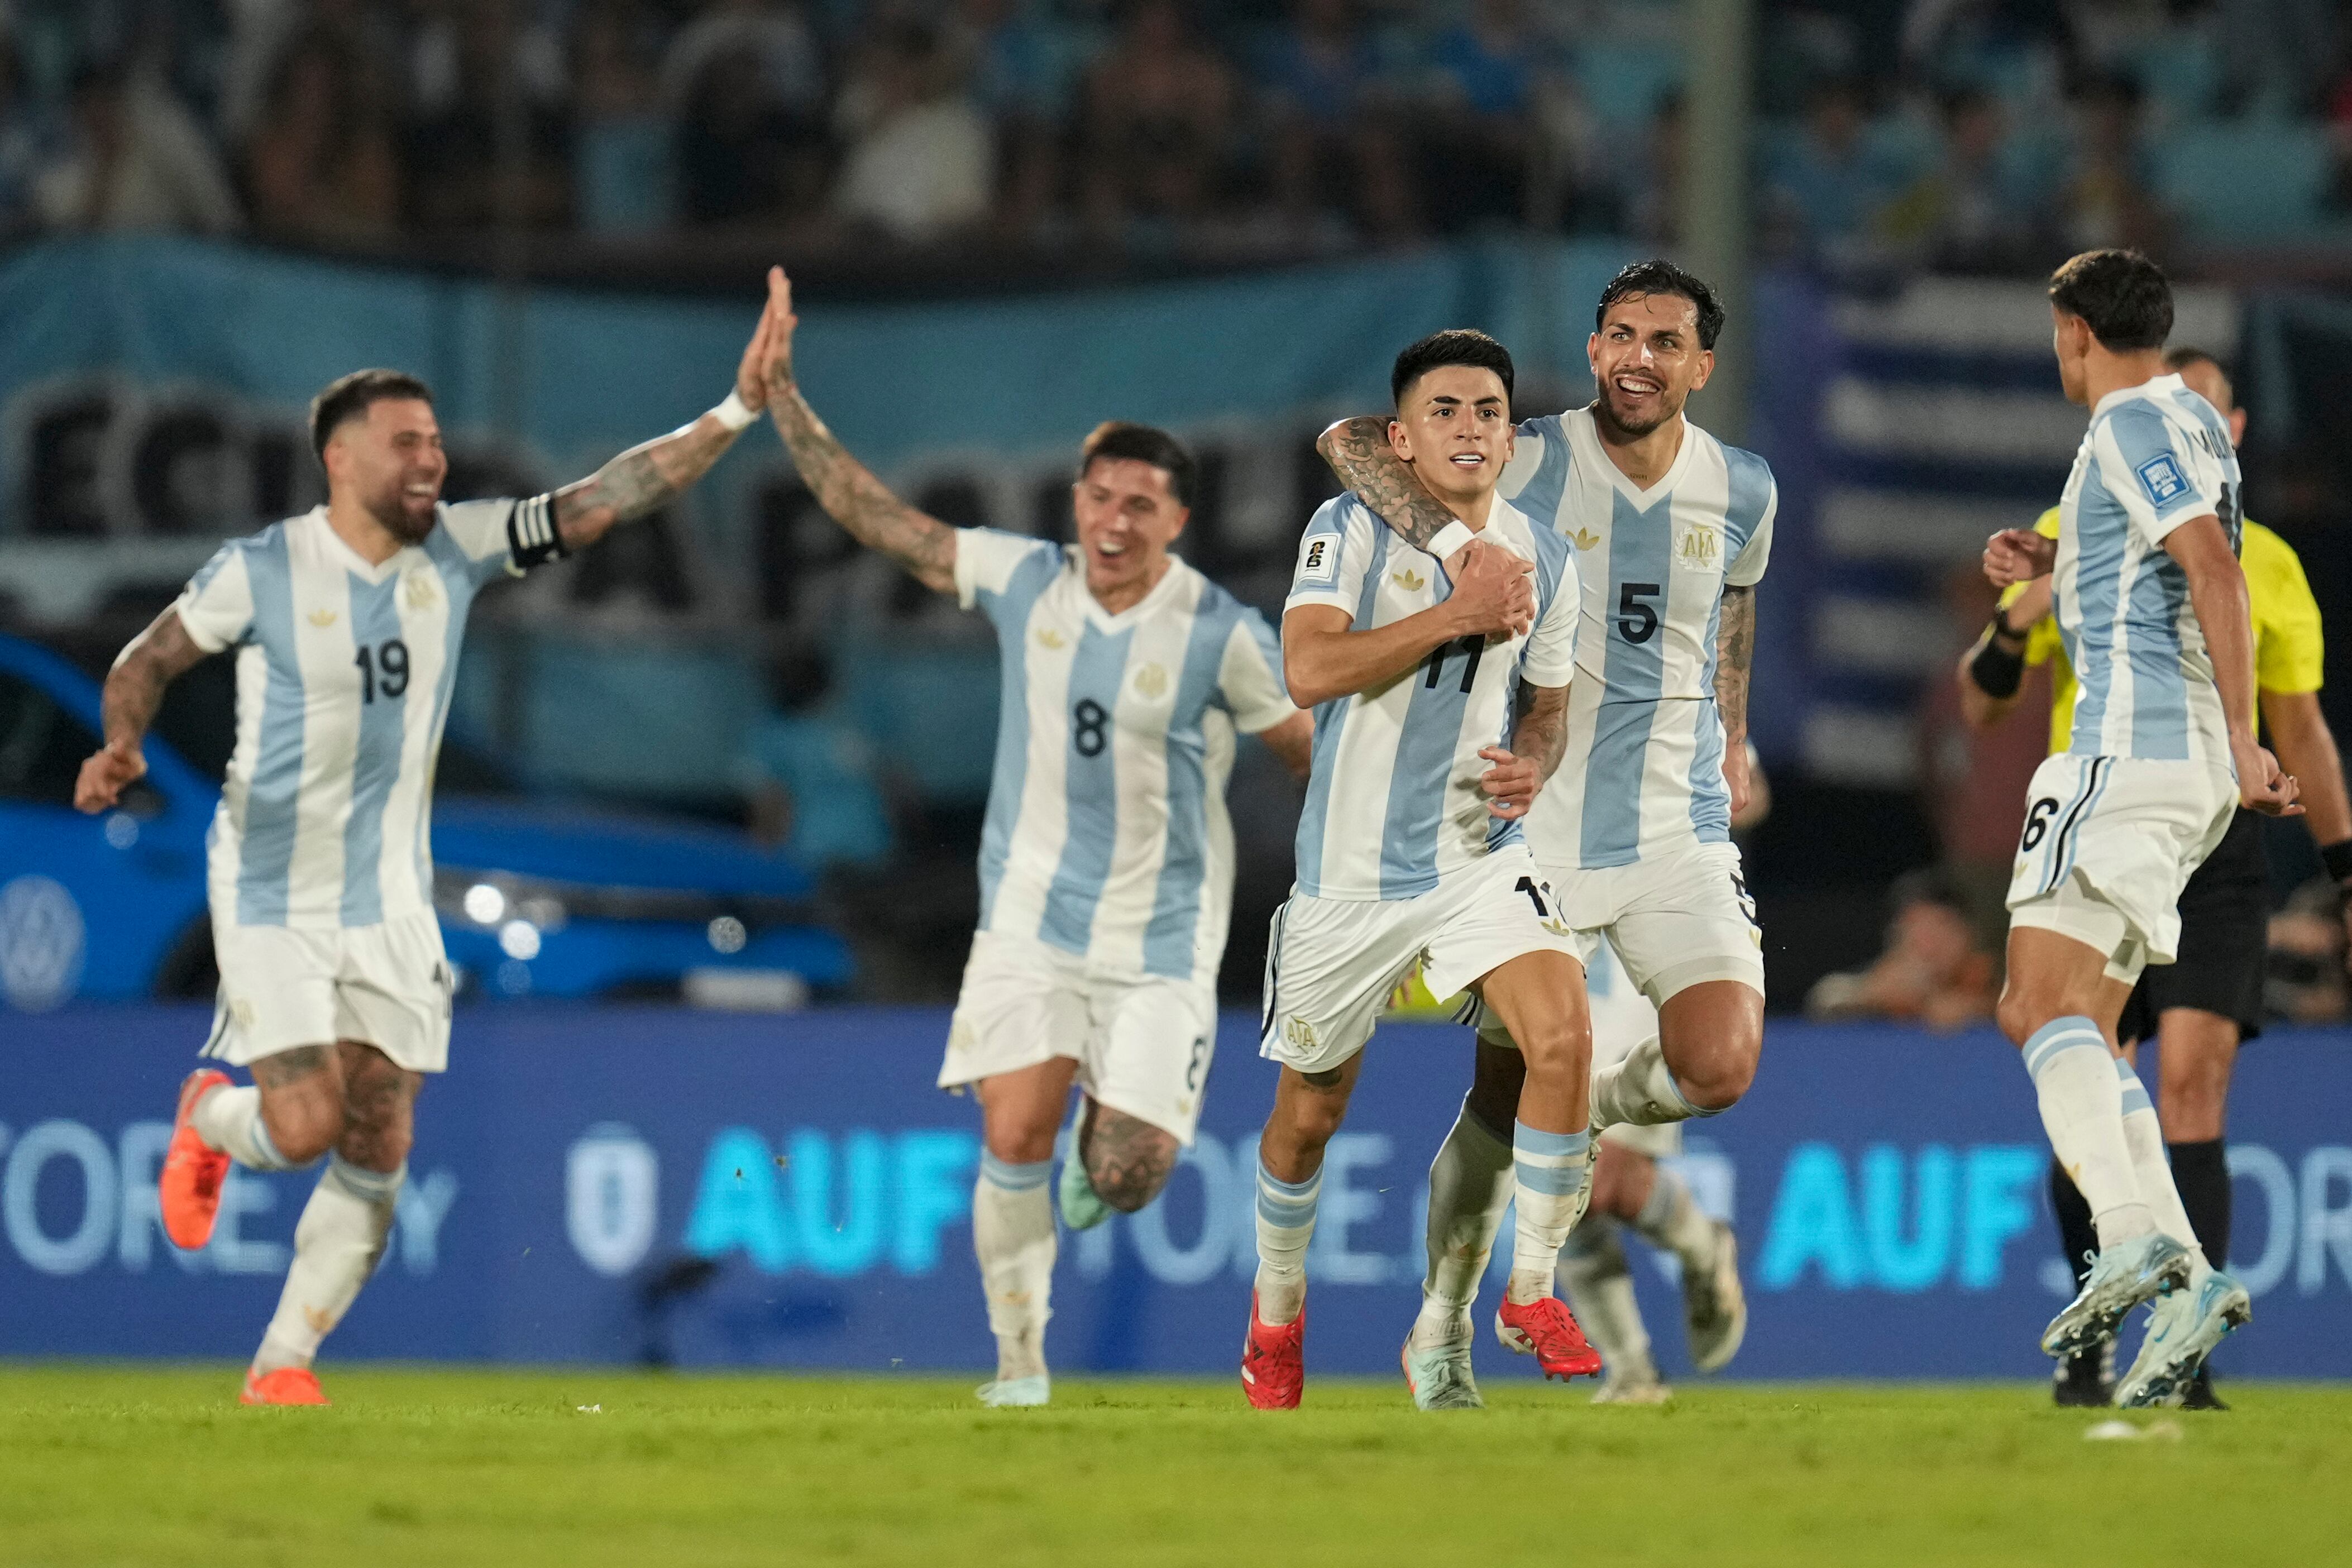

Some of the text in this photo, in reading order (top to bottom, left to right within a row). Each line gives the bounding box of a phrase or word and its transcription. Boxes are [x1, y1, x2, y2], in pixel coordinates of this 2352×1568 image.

[1618, 583, 1660, 644] 5
[355, 639, 410, 705] 19
[1075, 699, 1108, 757] 8
[682, 1124, 978, 1278] AUF
[1756, 1141, 2047, 1294] AUF
